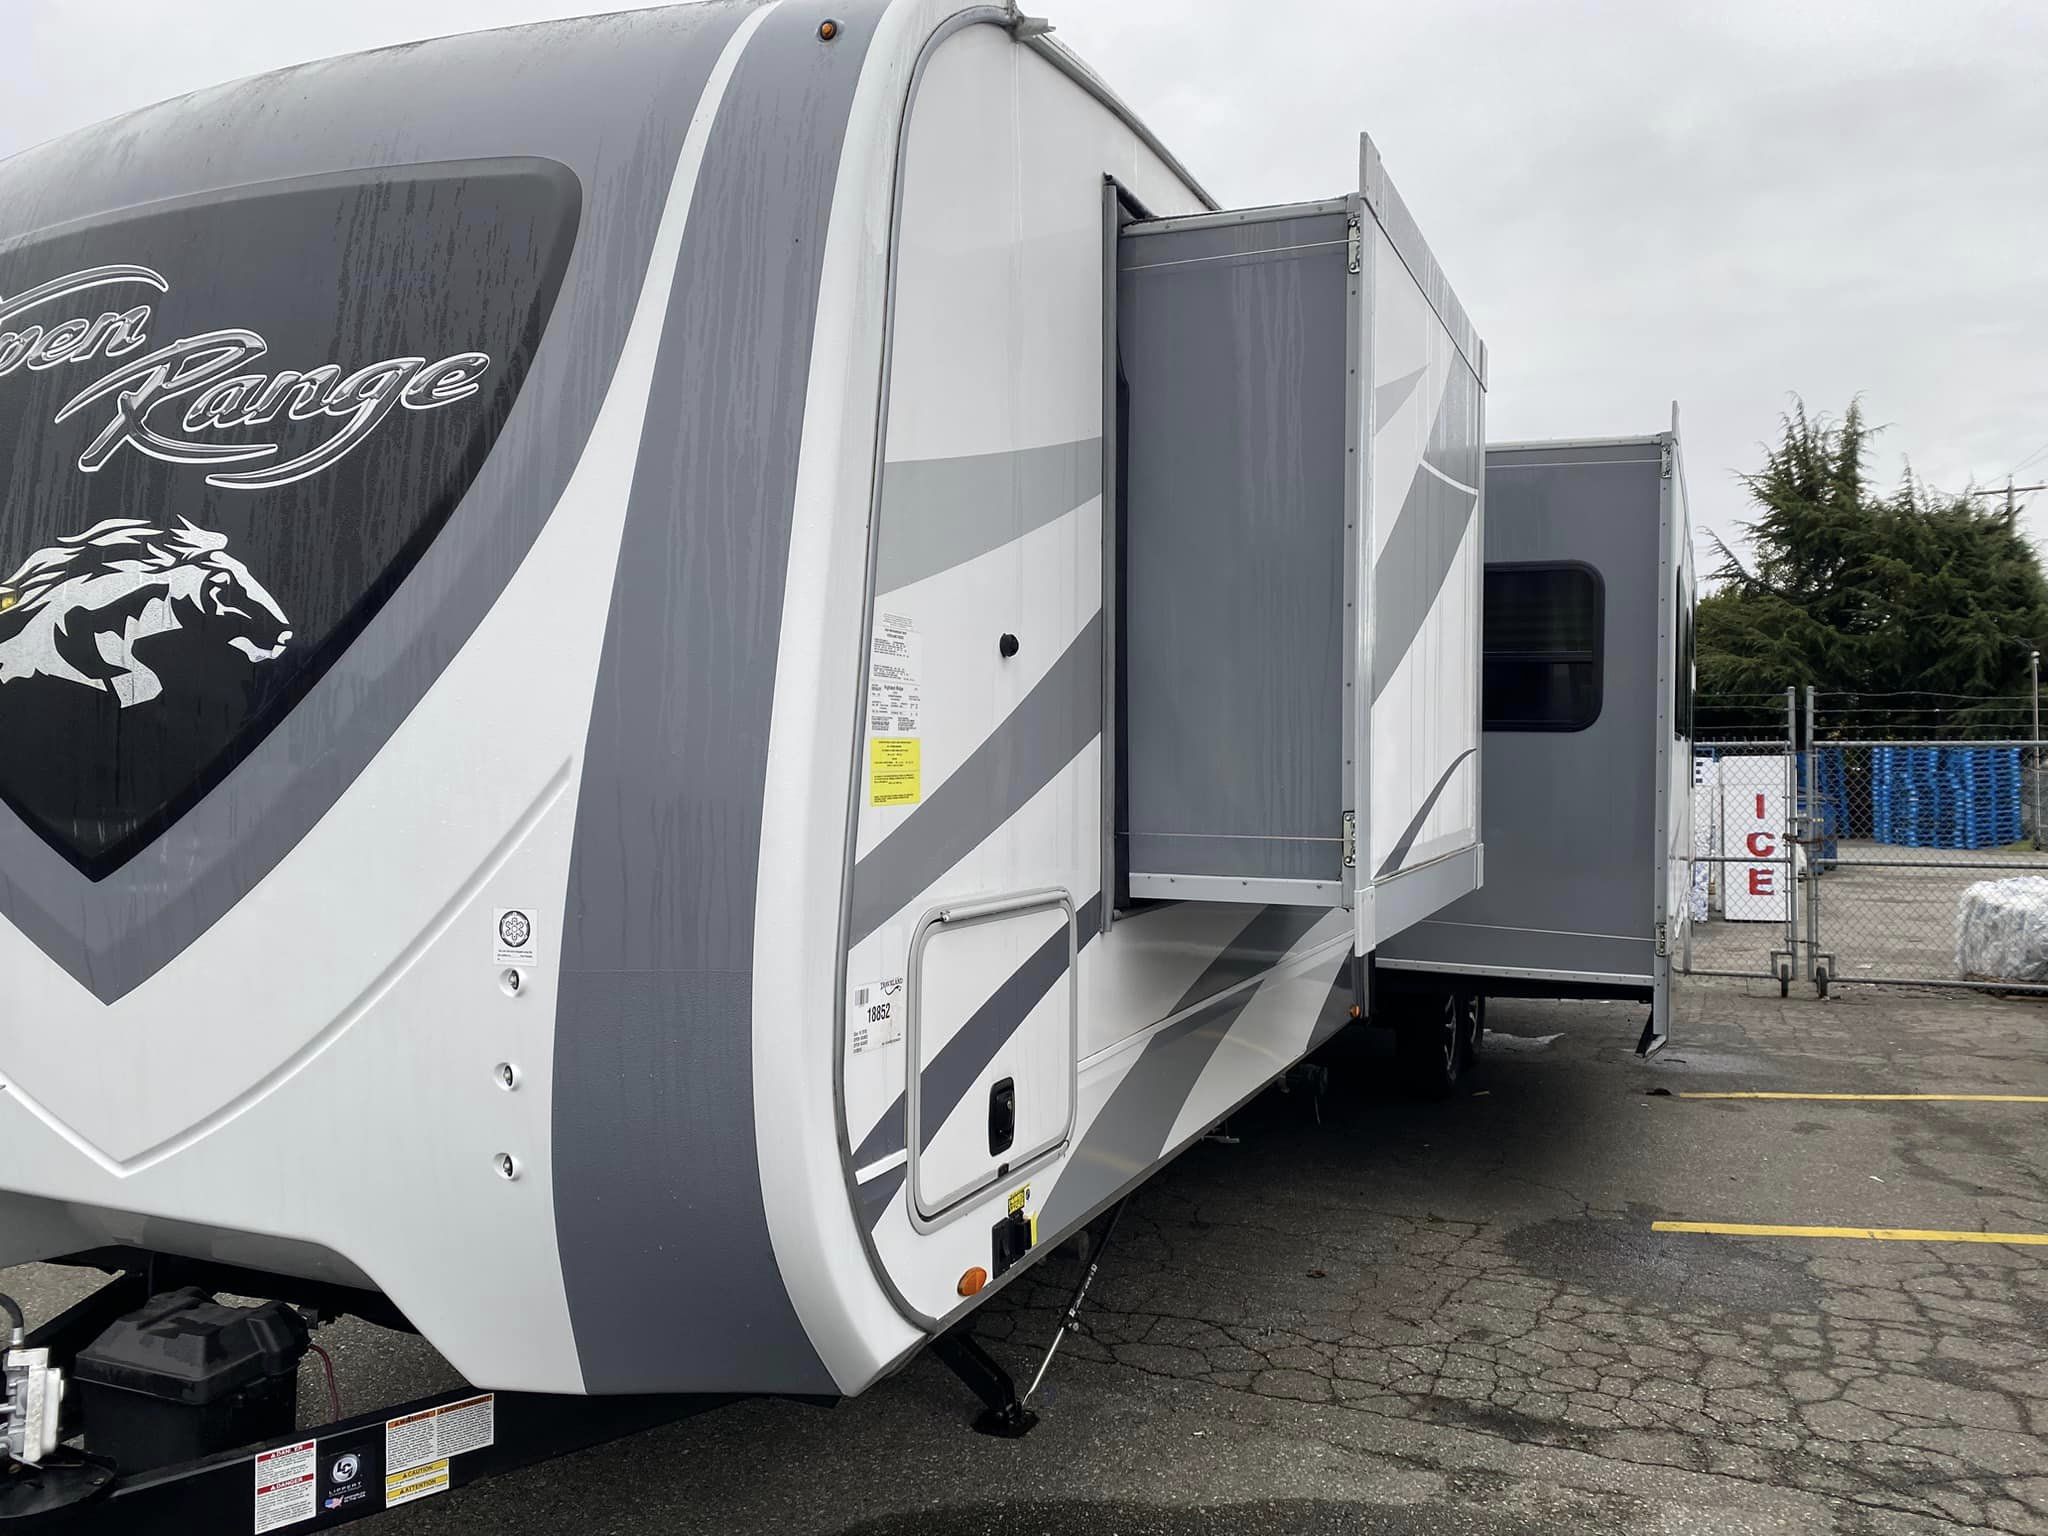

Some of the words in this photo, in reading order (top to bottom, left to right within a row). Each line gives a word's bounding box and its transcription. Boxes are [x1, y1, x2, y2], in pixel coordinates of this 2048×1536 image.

[54, 328, 490, 489] Range
[1747, 793, 1775, 896] ICE
[867, 1003, 891, 1023] 18852
[408, 1465, 433, 1477] CAUTION
[276, 1477, 303, 1488] DANGER
